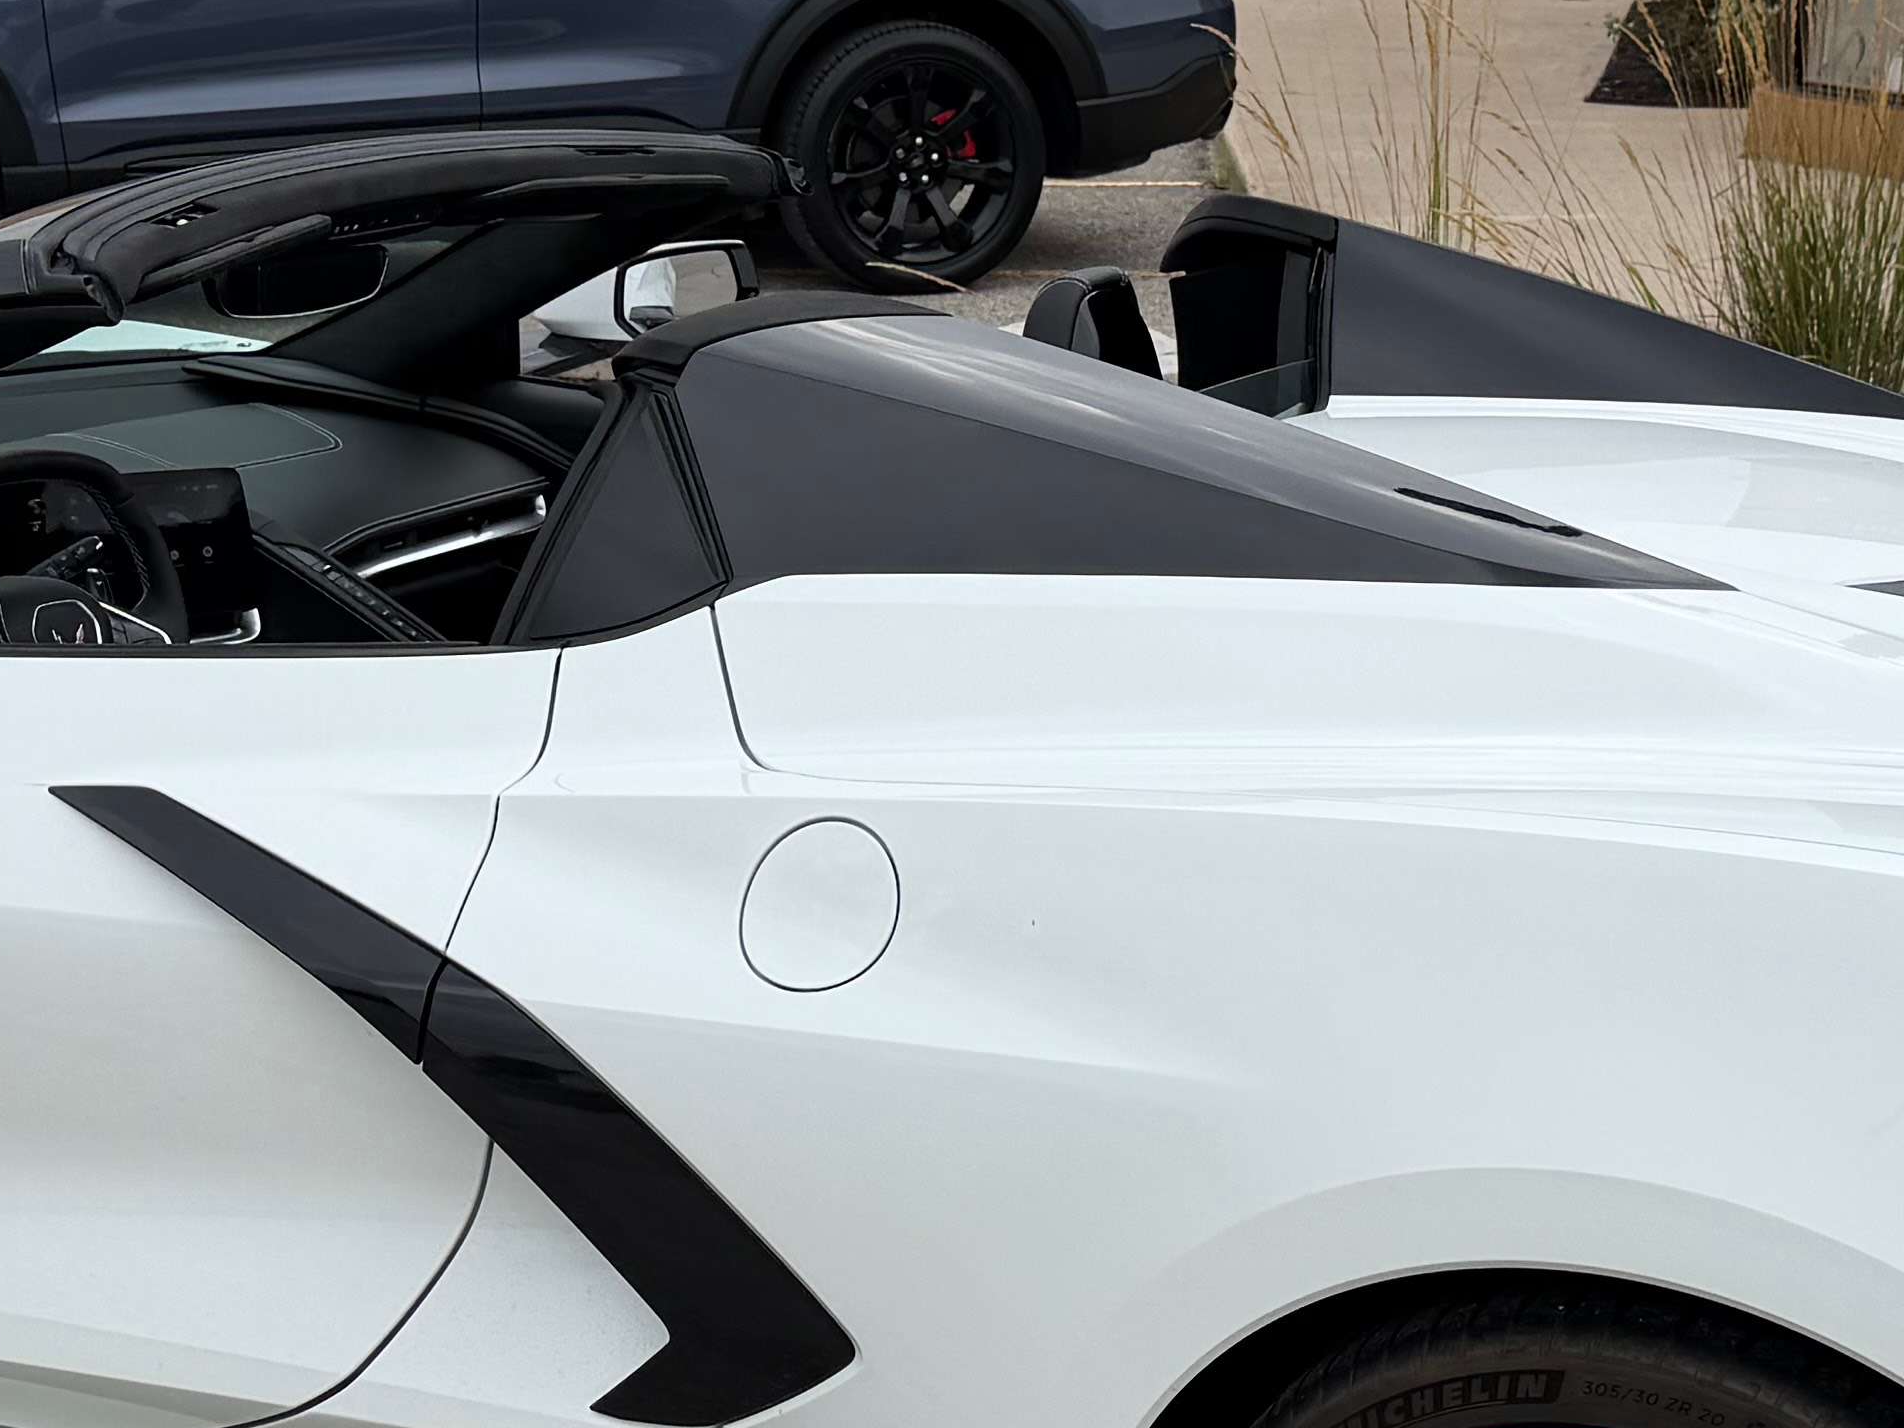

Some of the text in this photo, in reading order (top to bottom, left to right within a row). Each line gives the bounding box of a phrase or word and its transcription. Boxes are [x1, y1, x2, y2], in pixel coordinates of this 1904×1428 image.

[1582, 1378, 1660, 1407] 305/30
[1664, 1394, 1694, 1416] ZR
[1697, 1405, 1727, 1428] 20
